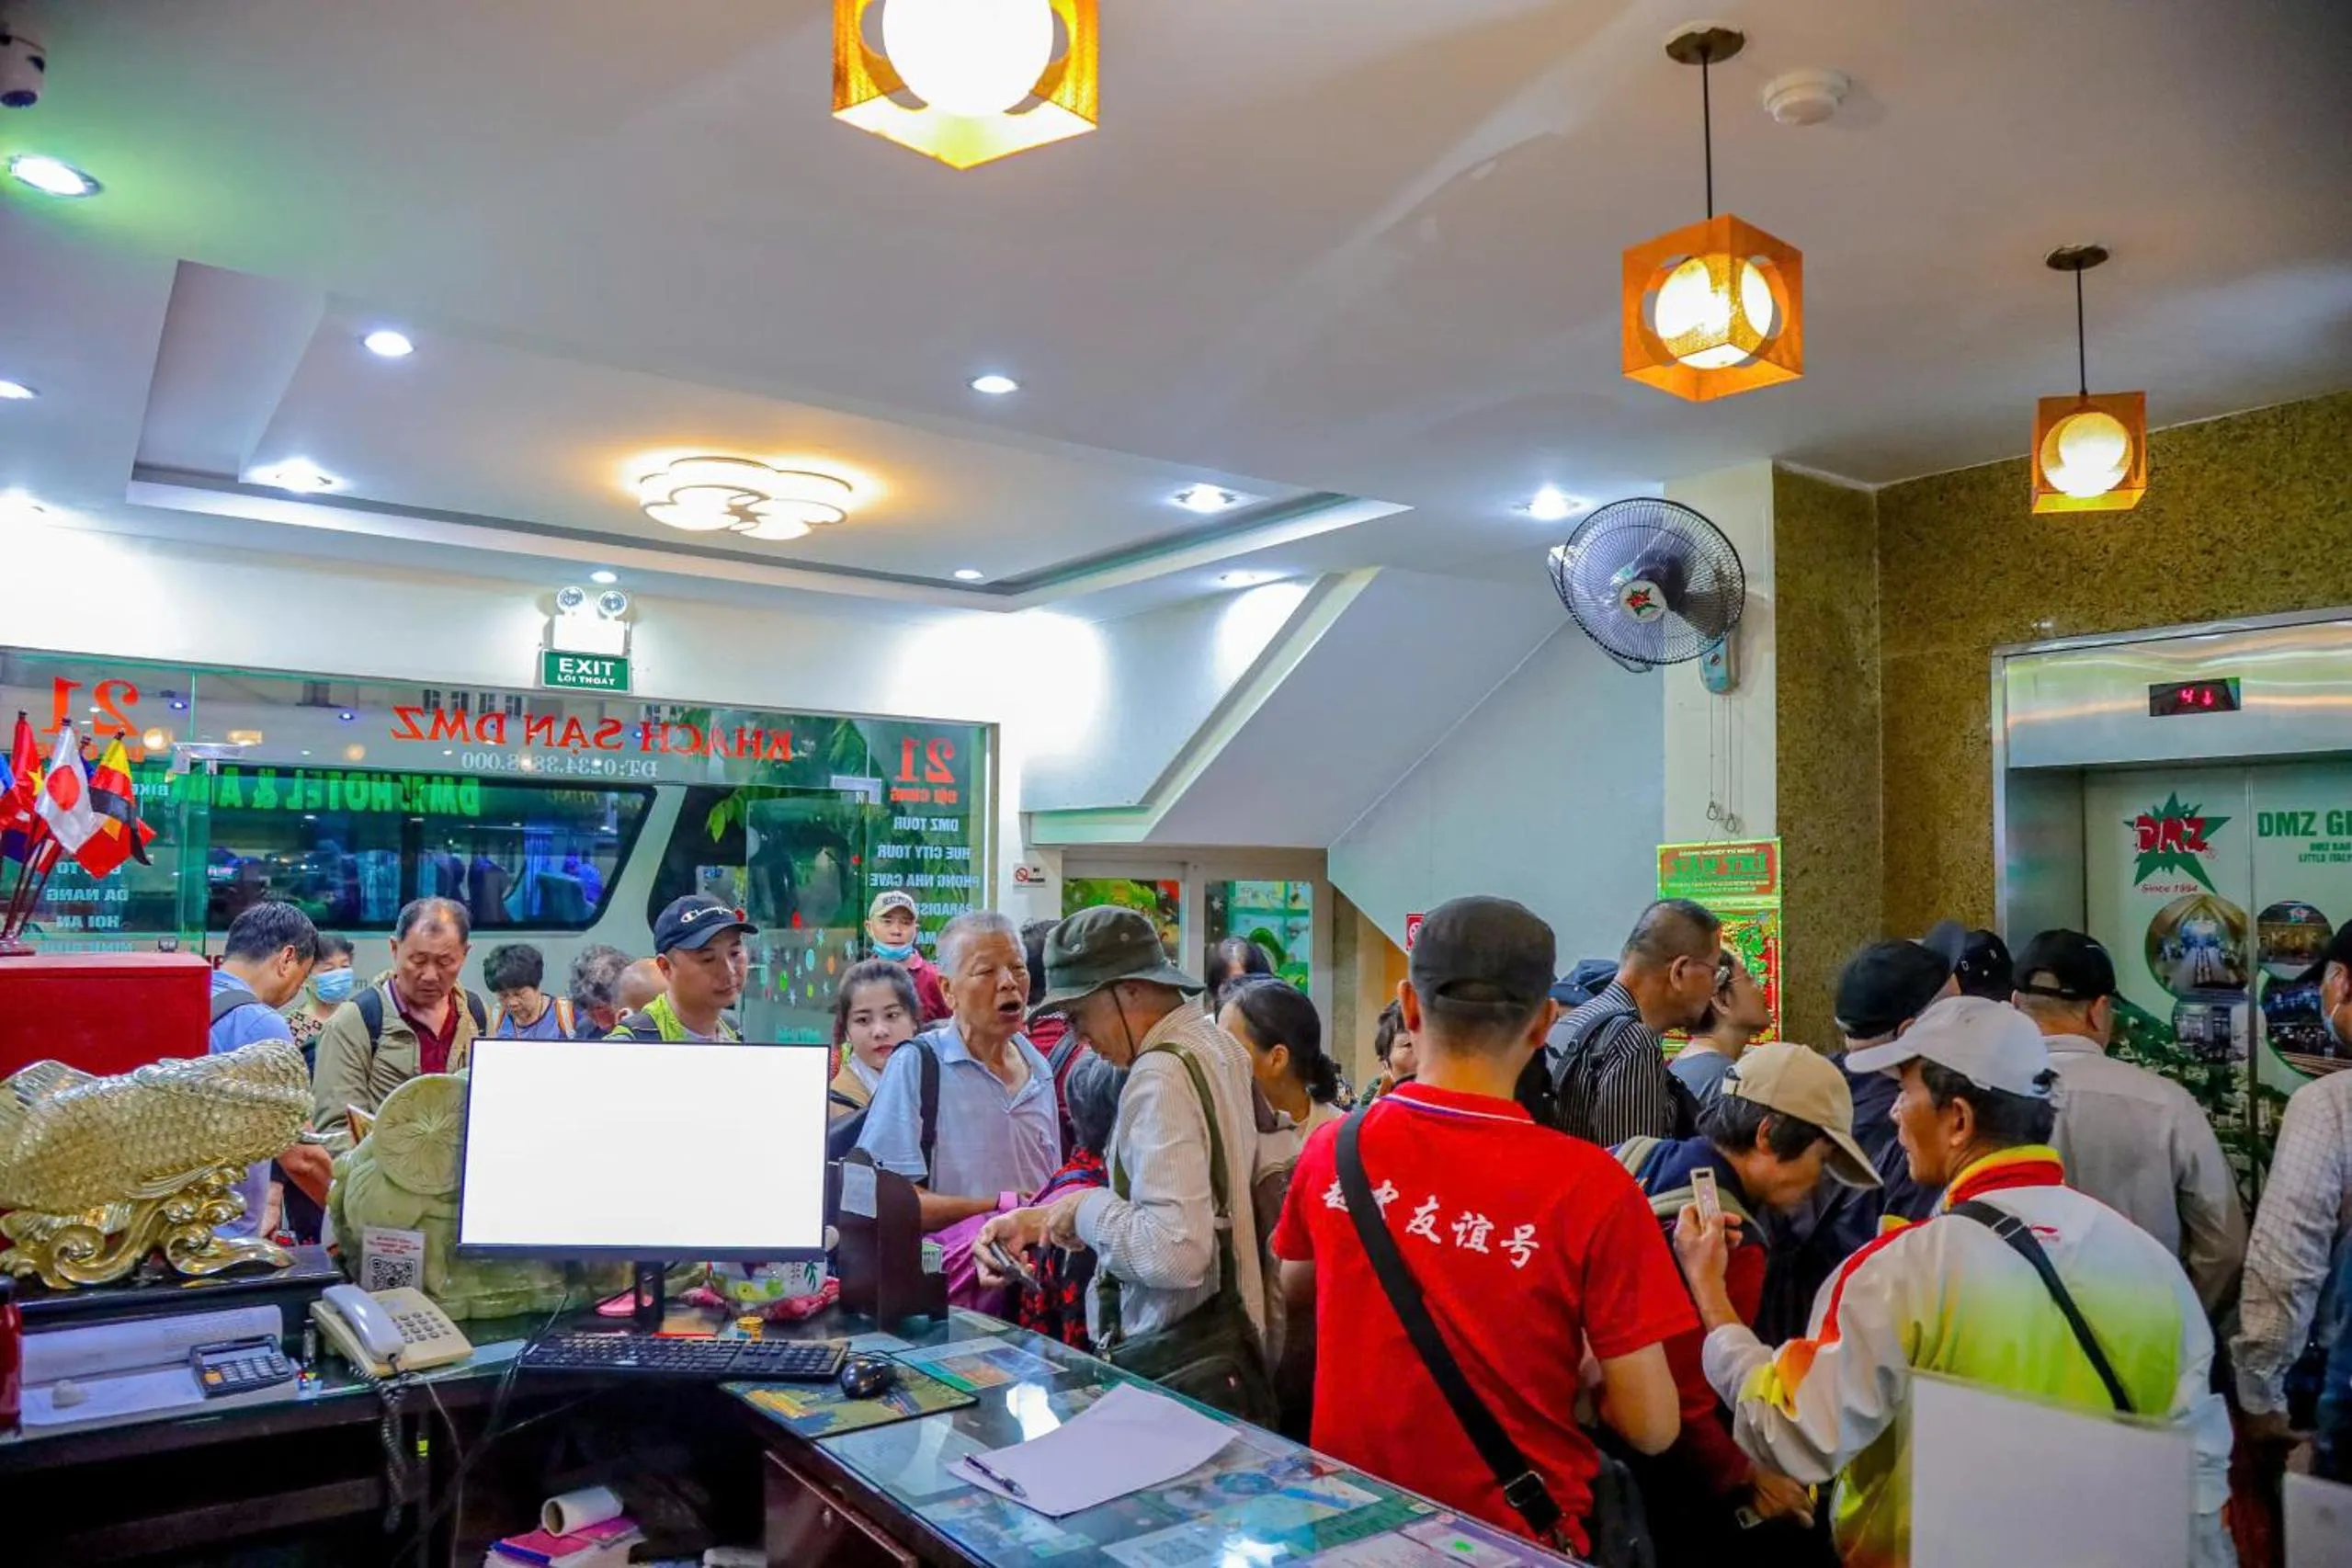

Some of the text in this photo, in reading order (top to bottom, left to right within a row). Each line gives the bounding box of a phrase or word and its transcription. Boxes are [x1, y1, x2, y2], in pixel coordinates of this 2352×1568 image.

[558, 657, 616, 676] EXIT
[2132, 814, 2209, 854] DMZ
[2257, 812, 2317, 837] DMZ
[2141, 883, 2171, 893] Since
